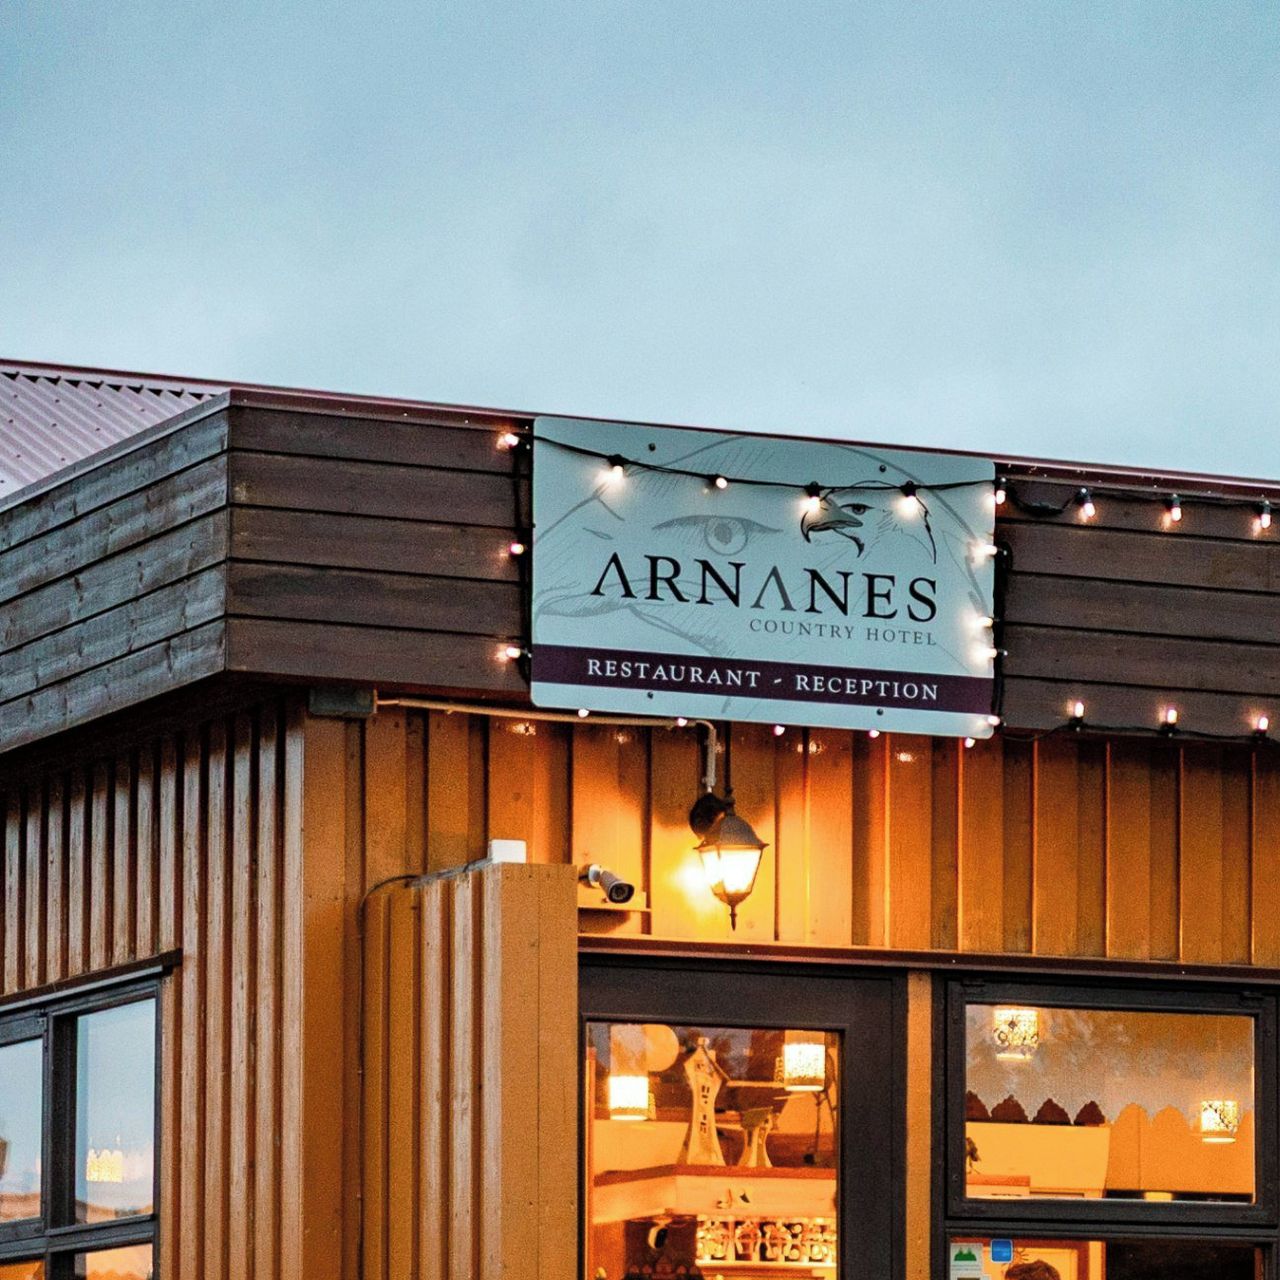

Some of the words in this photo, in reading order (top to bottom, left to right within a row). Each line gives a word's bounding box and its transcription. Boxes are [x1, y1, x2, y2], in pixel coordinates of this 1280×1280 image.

[591, 550, 938, 622] ARNANES
[749, 617, 855, 641] COUNTRY
[866, 626, 937, 647] HOTEL
[587, 657, 761, 689] RESTAURANT
[795, 673, 940, 701] RECEPTION
